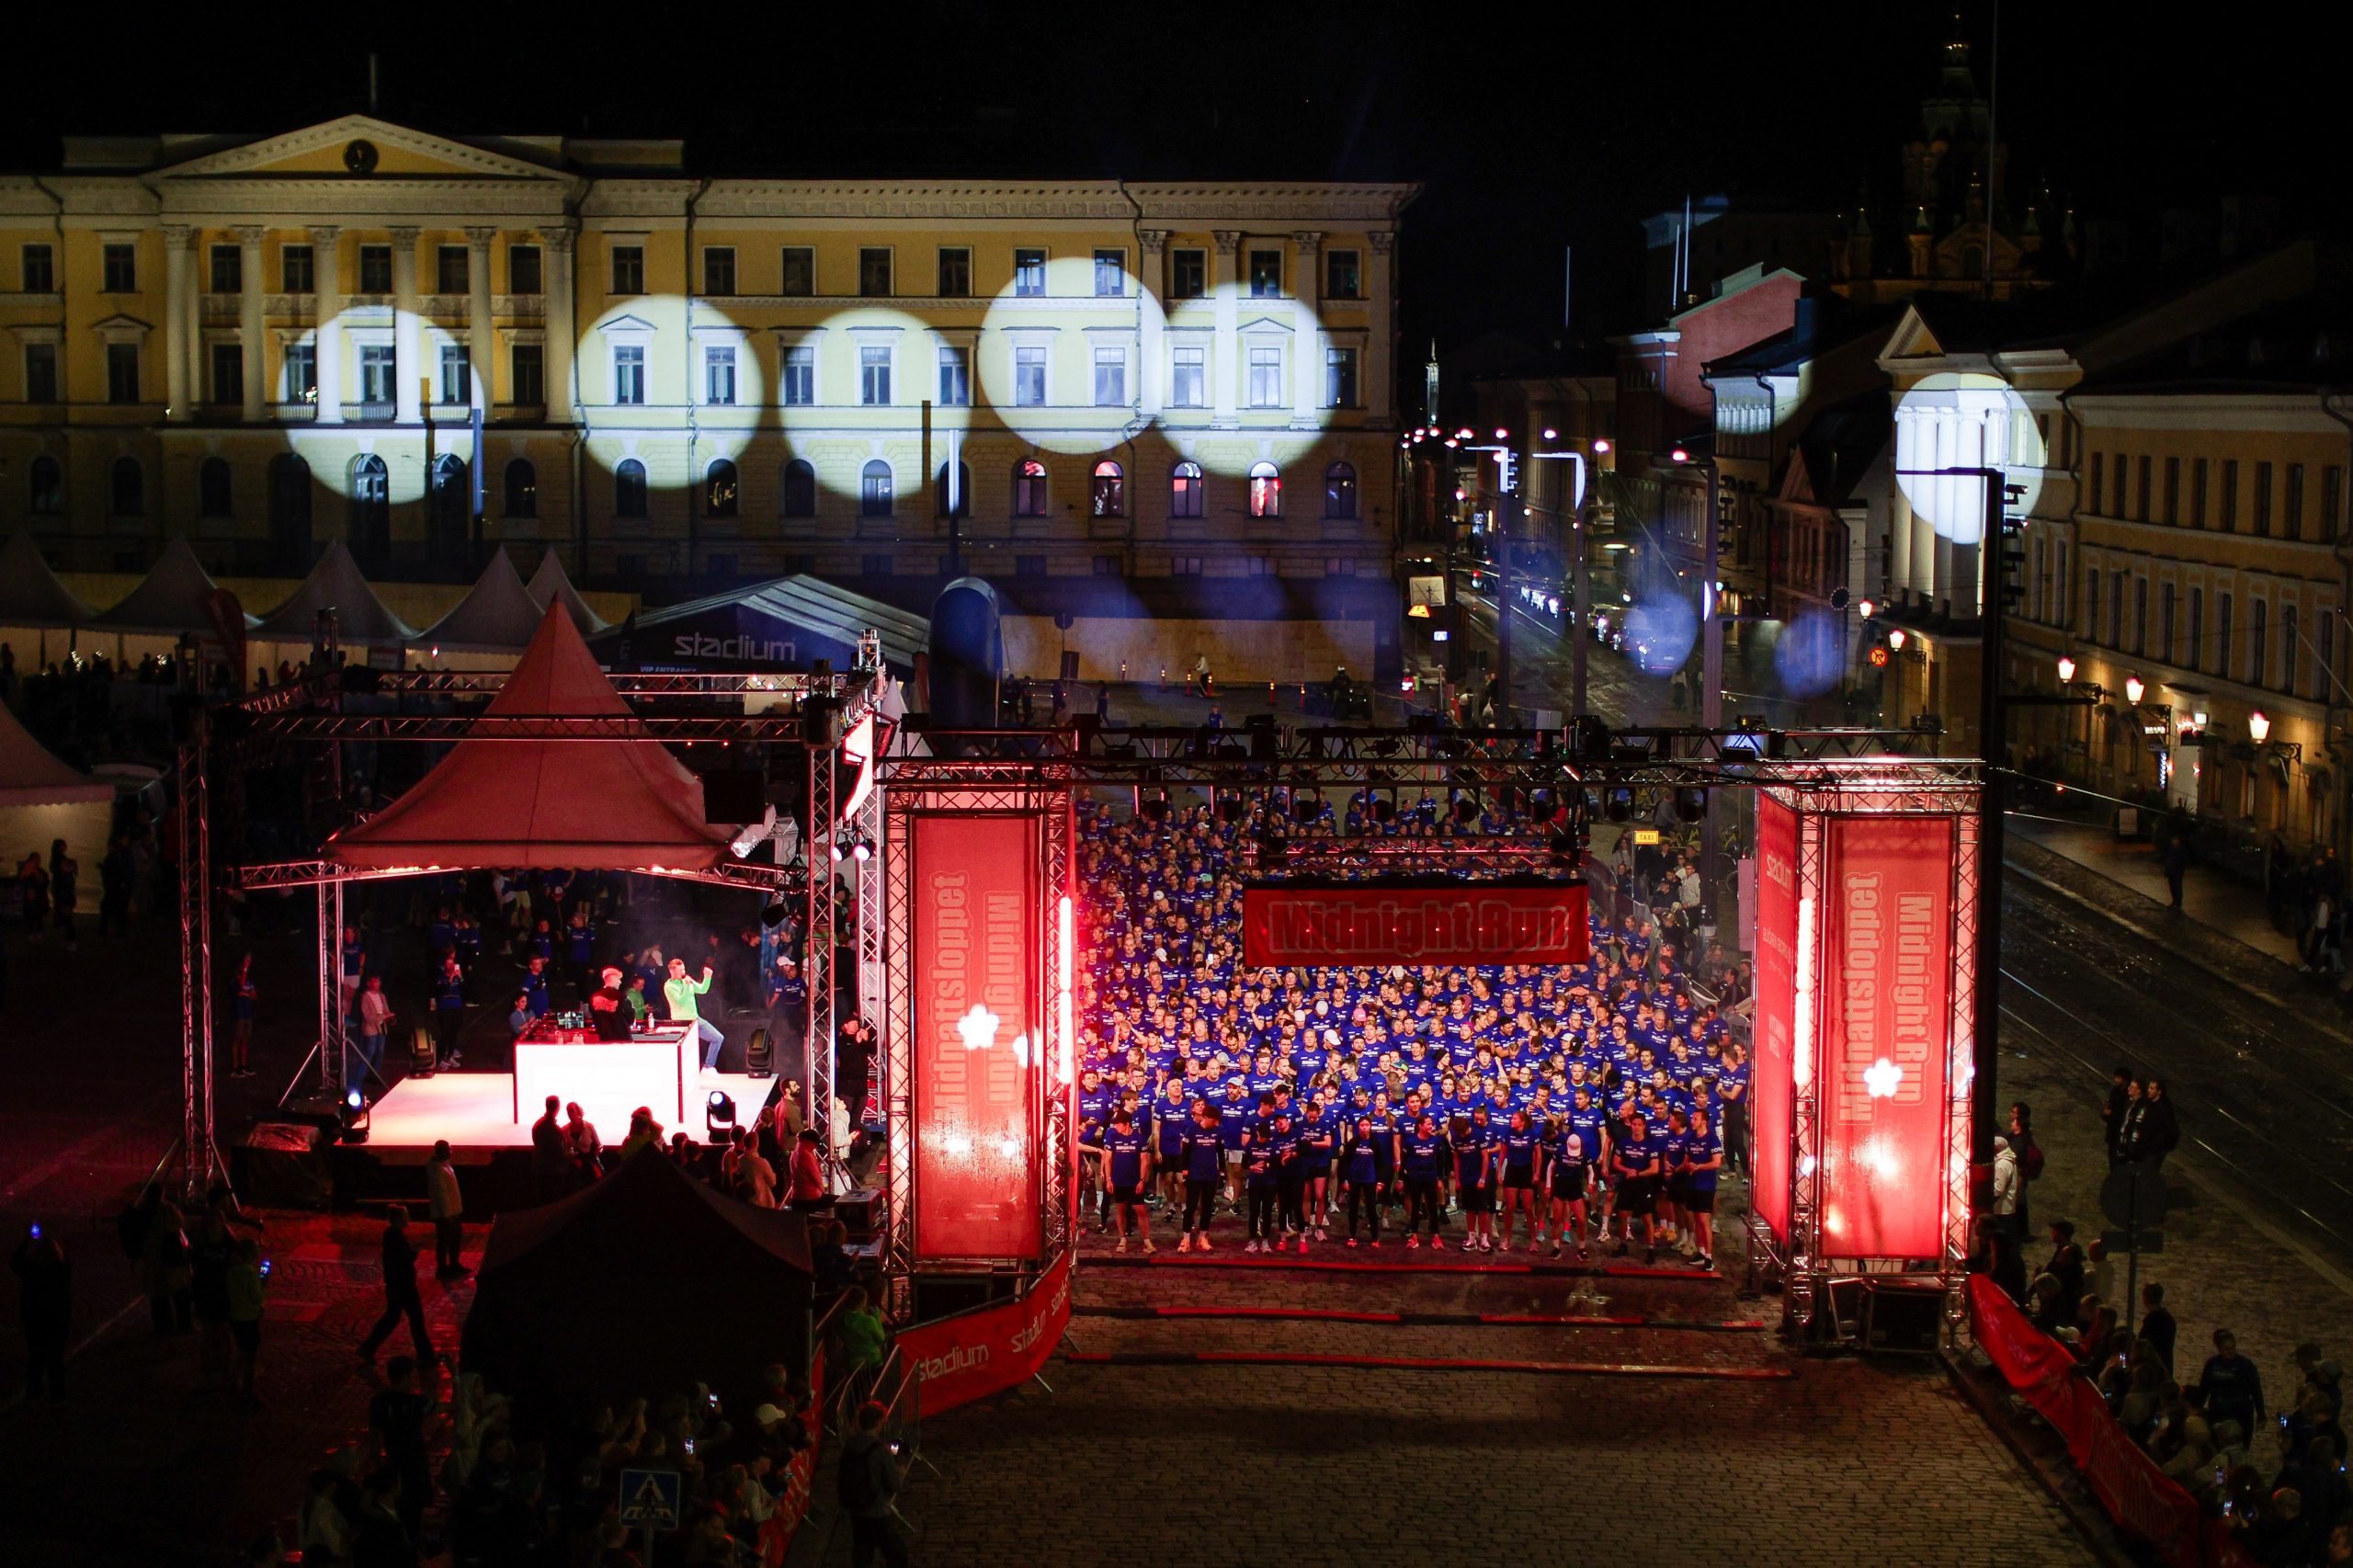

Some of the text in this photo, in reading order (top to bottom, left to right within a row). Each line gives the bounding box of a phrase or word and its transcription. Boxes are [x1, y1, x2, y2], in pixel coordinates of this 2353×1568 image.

[674, 632, 796, 662] stadium
[1268, 900, 1569, 958] Midnight Run
[1839, 876, 1881, 1121] Midnattsloppet
[1893, 896, 1931, 1102] Midnight Run
[919, 1345, 989, 1381] stadium
